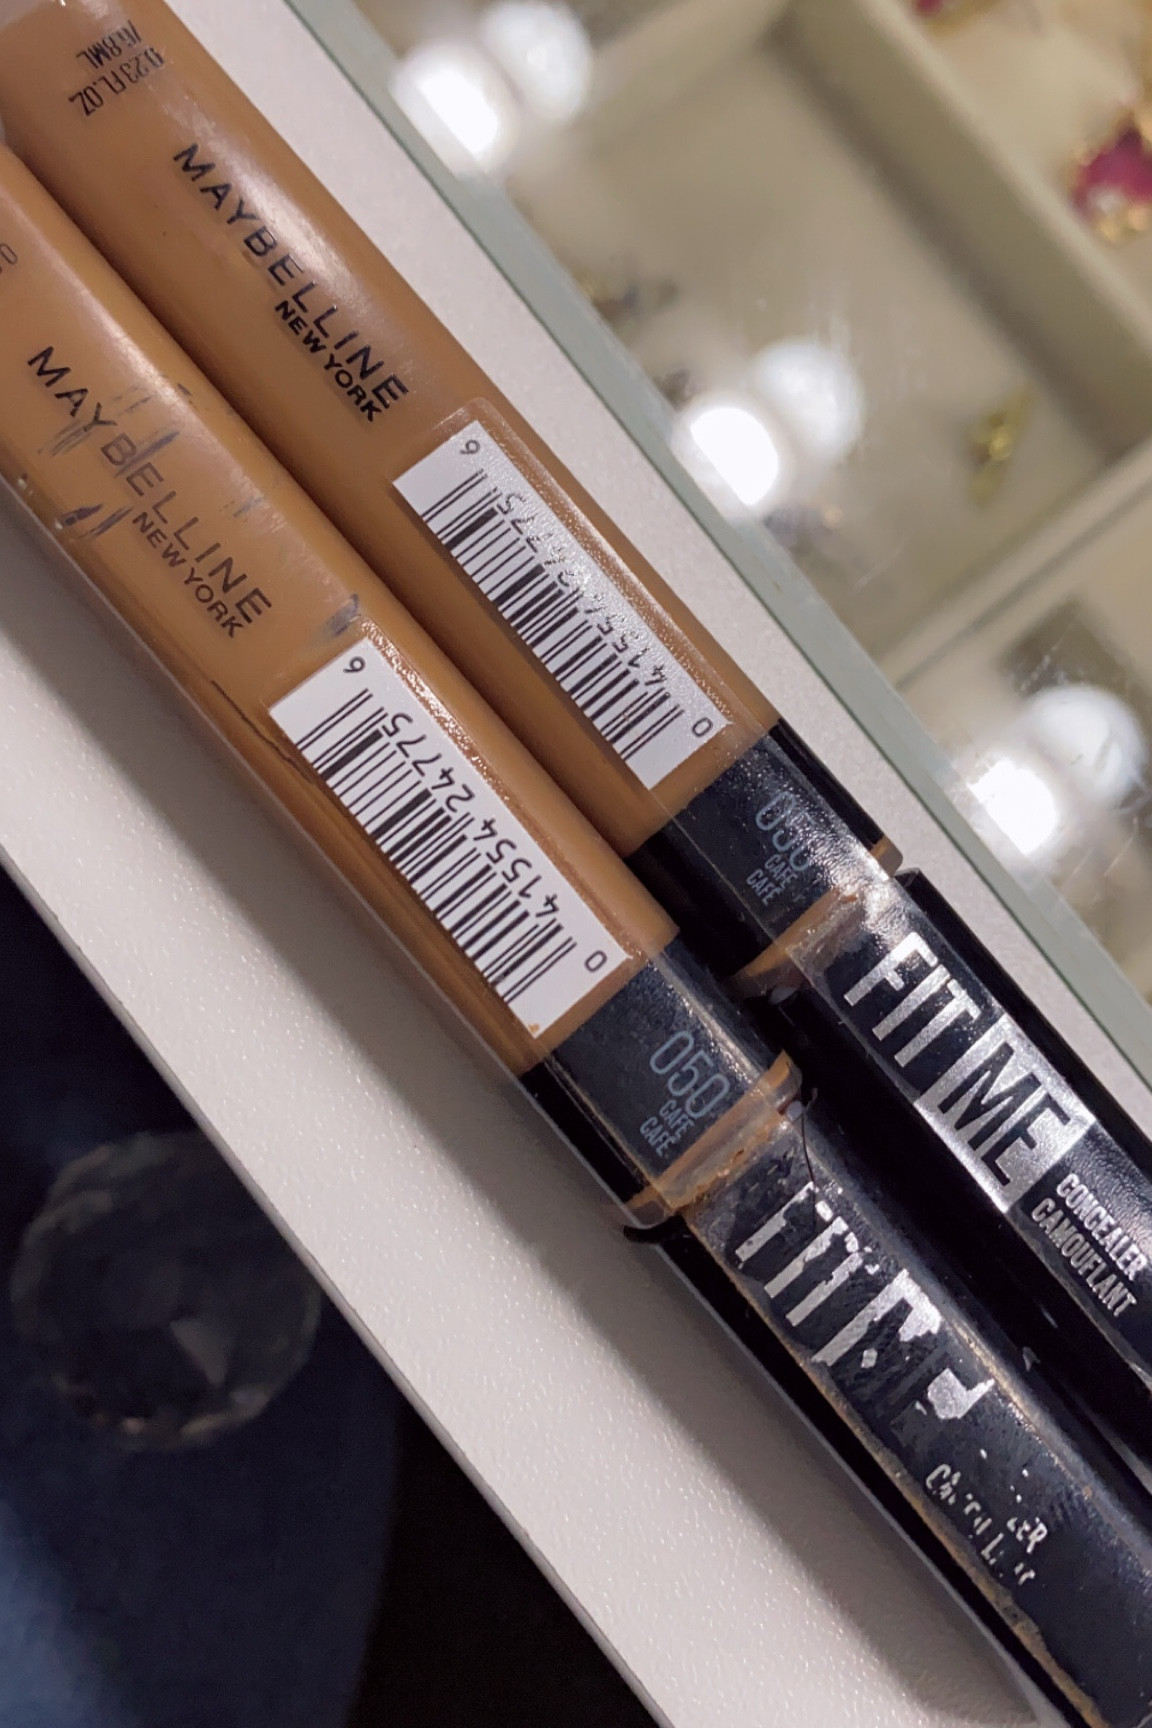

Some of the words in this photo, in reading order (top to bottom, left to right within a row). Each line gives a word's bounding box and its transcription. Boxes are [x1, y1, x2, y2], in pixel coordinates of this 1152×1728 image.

[173, 144, 409, 409] MAYBELLINE
[274, 300, 327, 353] NEW
[323, 353, 382, 422] YORK
[27, 345, 272, 624] MAYBELLINE
[459, 439, 480, 455] 6
[132, 511, 187, 567] NEW
[183, 567, 244, 638] YORK
[343, 656, 366, 673] 6
[381, 712, 476, 813] 24775
[692, 717, 713, 737] 0
[473, 818, 560, 918] 41554
[584, 950, 608, 973] 0
[649, 1030, 730, 1118] 050
[843, 931, 982, 1068] FIT
[937, 1040, 1072, 1187] ME
[1031, 1197, 1138, 1317] CAMOUFLANT
[1056, 1172, 1148, 1282] CONCEALER
